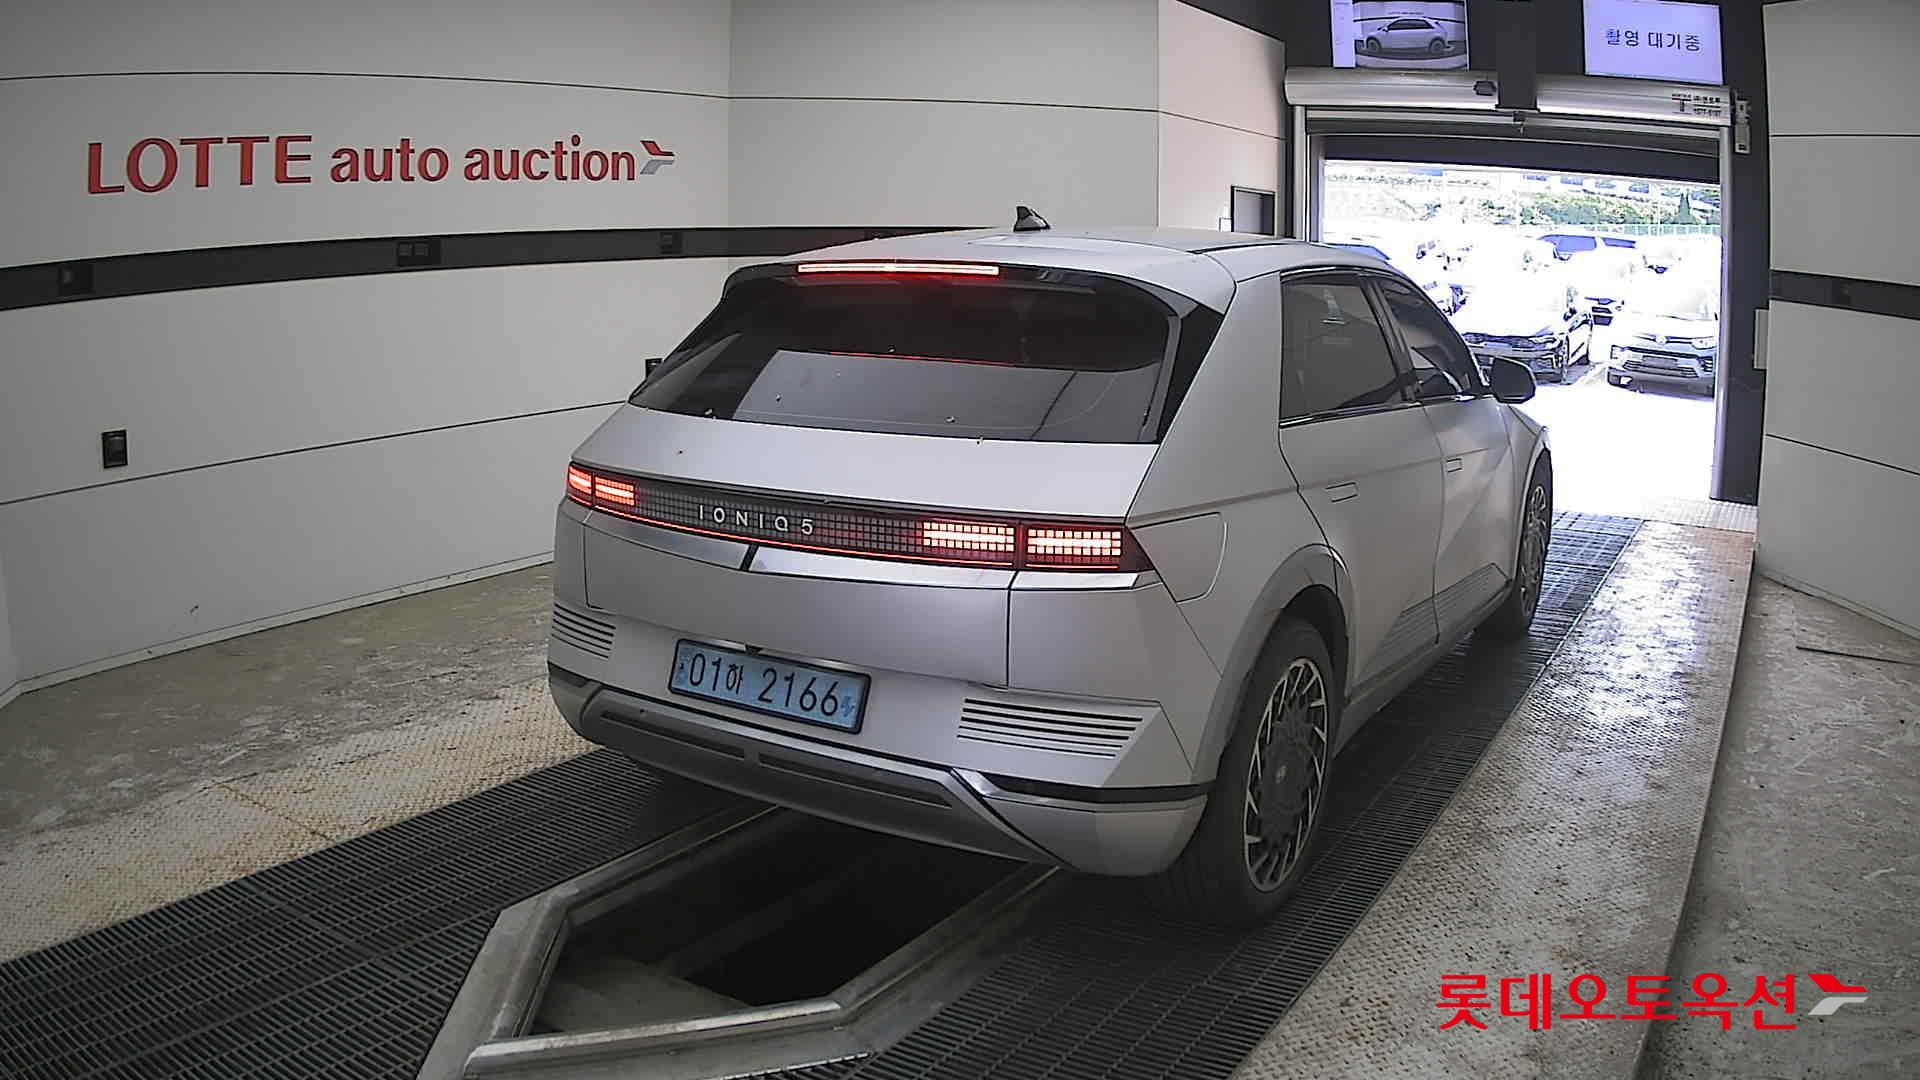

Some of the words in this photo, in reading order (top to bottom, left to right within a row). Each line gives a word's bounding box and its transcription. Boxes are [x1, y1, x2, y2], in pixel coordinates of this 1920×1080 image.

[1648, 32, 1700, 52] 대기중
[87, 135, 311, 194] LOTTE
[329, 138, 449, 182] auto
[463, 134, 635, 182] auction
[699, 505, 788, 532] IONIQ
[801, 519, 814, 534] 5
[758, 668, 839, 716] 2166
